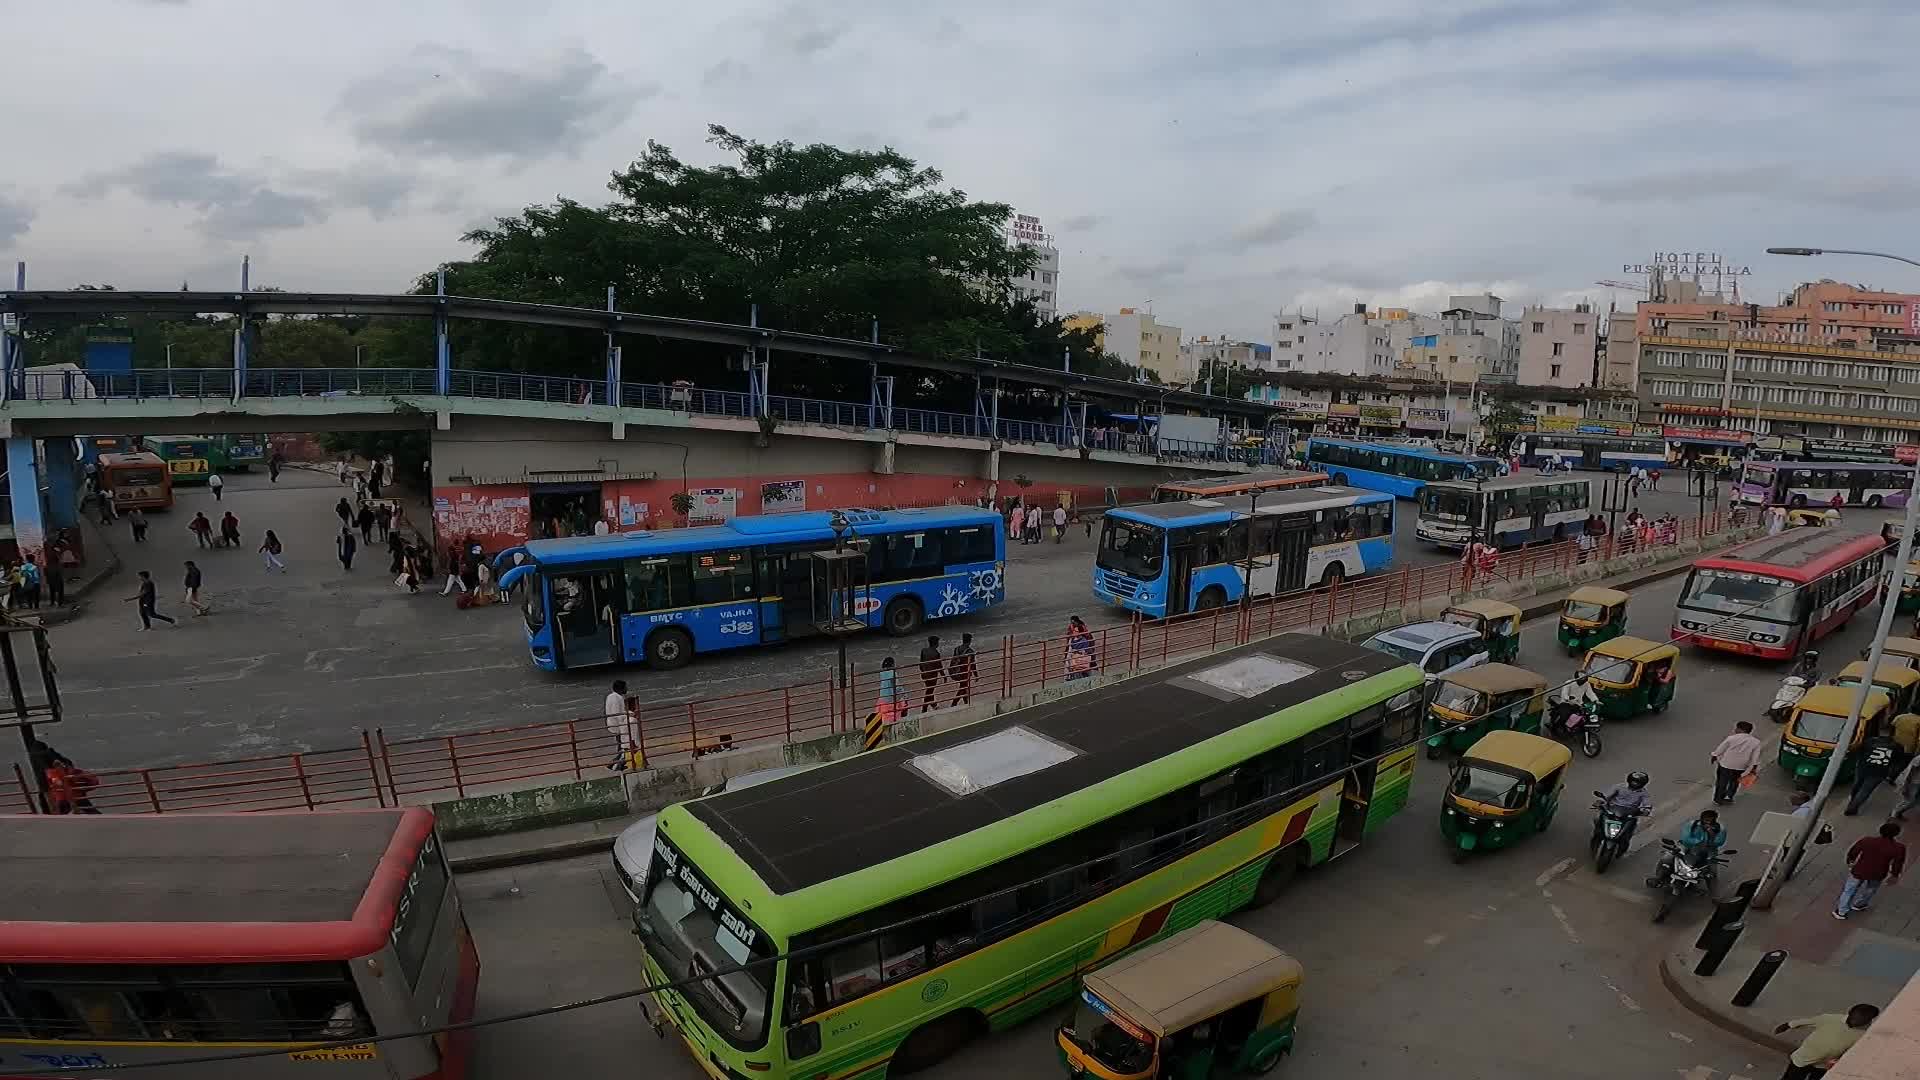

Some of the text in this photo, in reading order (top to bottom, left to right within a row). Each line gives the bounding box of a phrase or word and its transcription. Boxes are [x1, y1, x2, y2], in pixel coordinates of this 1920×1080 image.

[1655, 252, 1720, 263] HOTEL
[650, 612, 683, 623] BMTC
[720, 608, 753, 618] VAJRA
